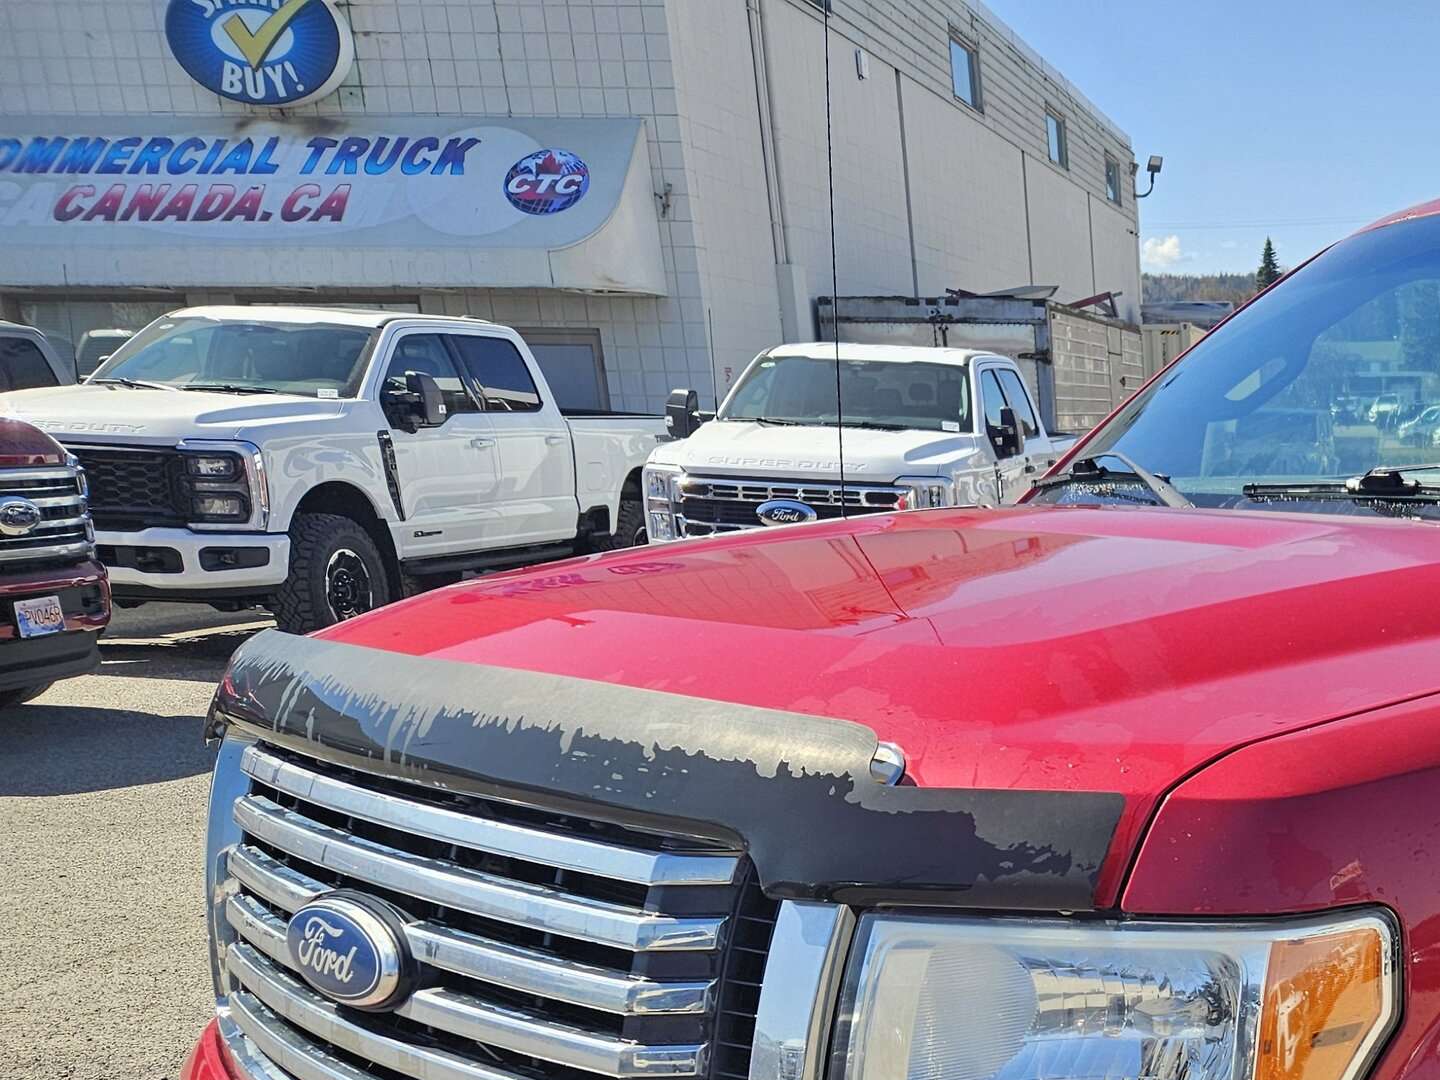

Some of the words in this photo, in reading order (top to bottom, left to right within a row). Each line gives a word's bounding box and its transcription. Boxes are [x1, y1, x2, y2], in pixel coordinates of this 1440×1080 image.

[221, 60, 304, 99] BUY!
[299, 136, 481, 176] TRUCK
[53, 183, 352, 222] CANADA.CA
[508, 173, 583, 194] CTC
[771, 508, 800, 522] Ford
[299, 916, 358, 983] Ford
